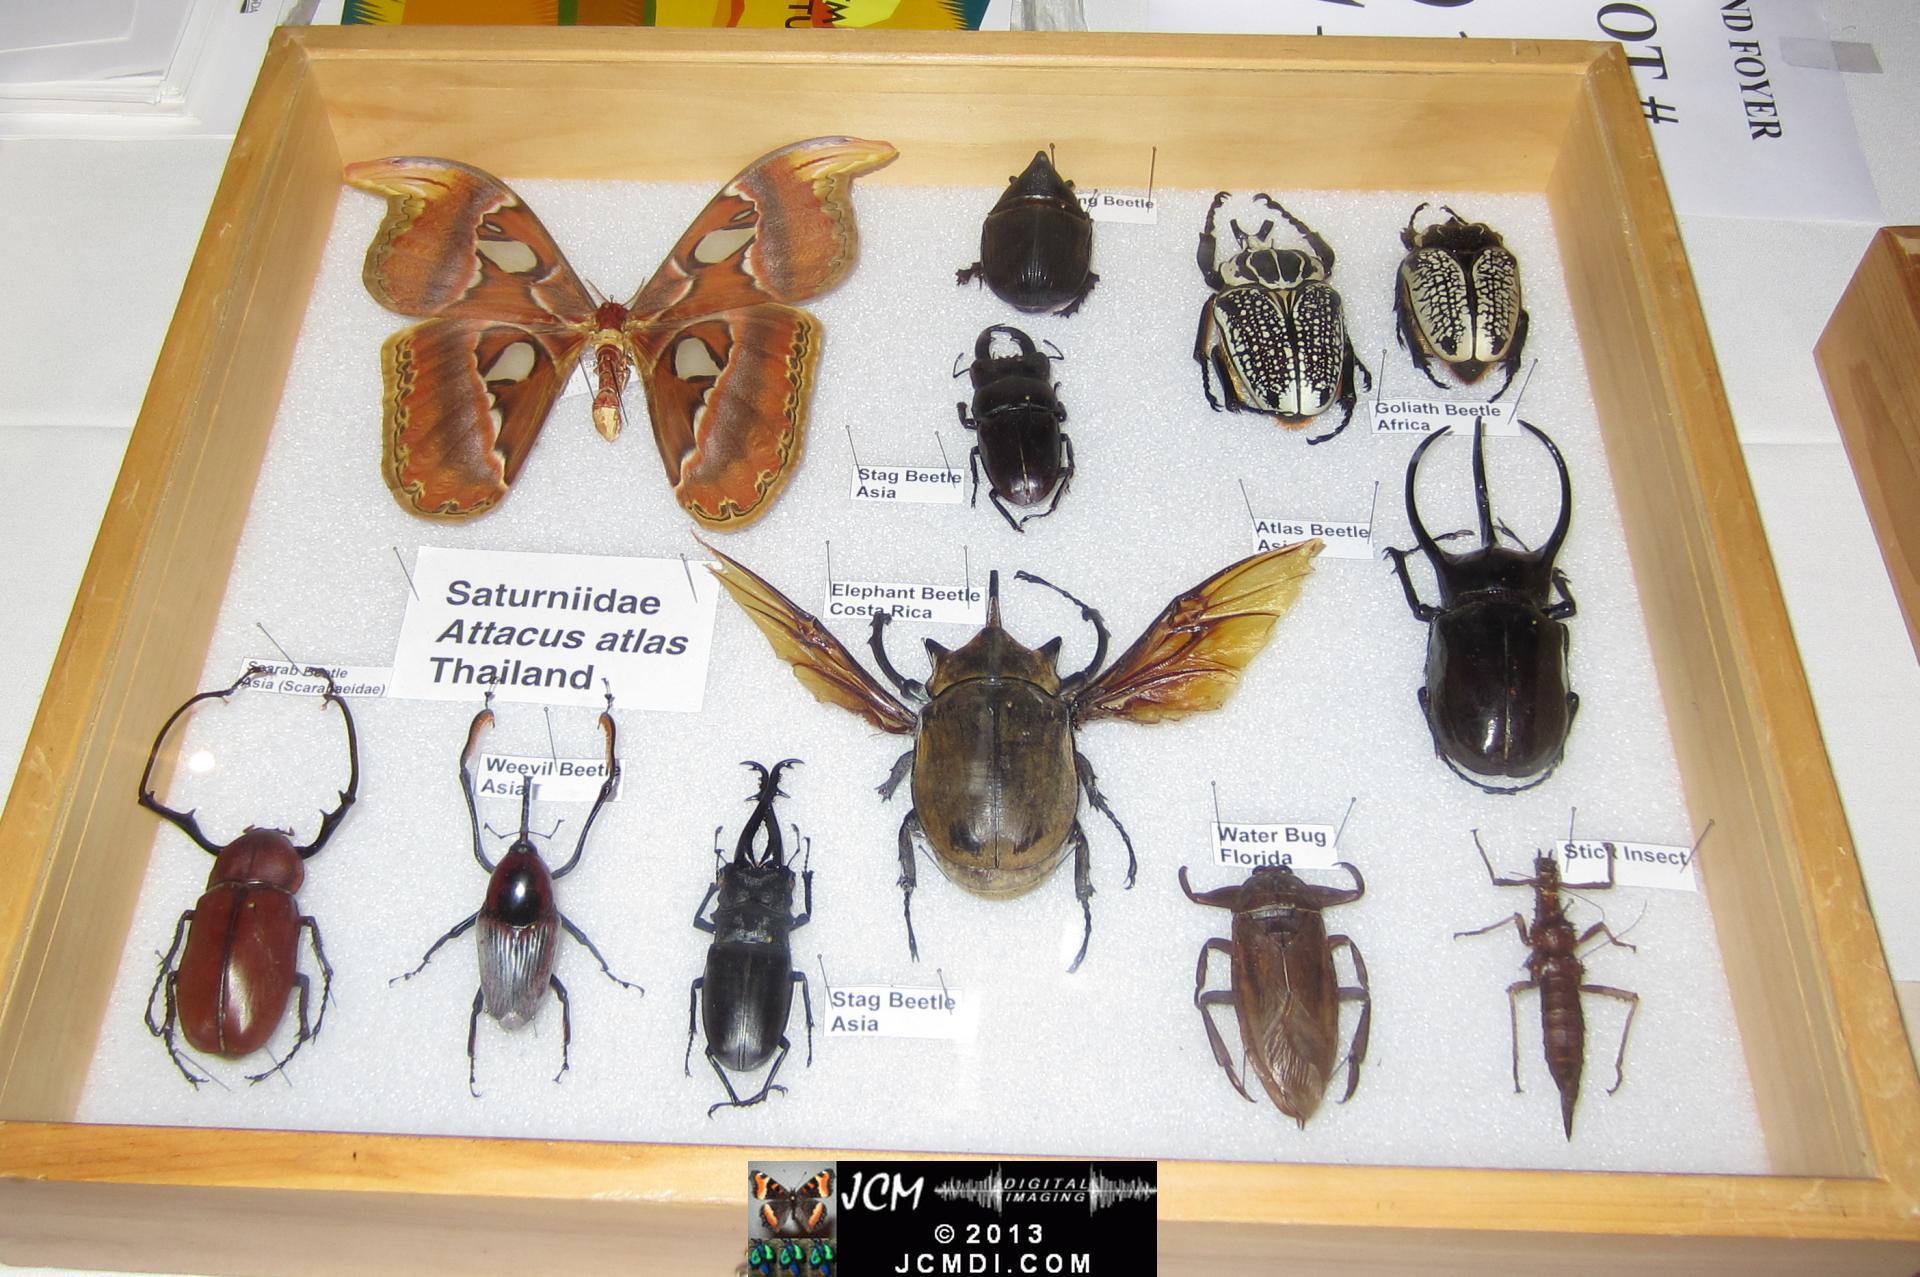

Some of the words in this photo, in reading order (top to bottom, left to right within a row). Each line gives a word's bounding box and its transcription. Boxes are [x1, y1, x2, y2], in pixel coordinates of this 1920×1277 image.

[1597, 0, 1668, 80] OT
[1728, 39, 1782, 140] FOYER
[1077, 197, 1098, 208] ng
[1103, 195, 1154, 209] Beetle
[1376, 401, 1440, 415] Goliath
[1445, 403, 1501, 417] Beetle
[1377, 418, 1431, 432] Africa
[858, 468, 899, 484] Stag
[905, 469, 962, 484] Beetle
[856, 485, 897, 499] Asia
[1256, 521, 1304, 535] Atlas
[1310, 523, 1369, 538] Beetle
[446, 580, 661, 615] Saturniidae
[832, 583, 916, 600] Elephant
[921, 586, 981, 602] Beetle
[830, 602, 885, 616] Costa
[891, 604, 933, 619] Rica
[435, 619, 586, 649] Attacus
[595, 628, 689, 655] atlas
[429, 656, 595, 690] Thailand
[278, 679, 386, 697] (Scaraaeidae)
[486, 757, 554, 776] Weevil
[1219, 826, 1279, 843] Water
[1285, 827, 1327, 848] Bug
[1220, 848, 1293, 865] Florida
[1564, 843, 1618, 860] Stic
[1624, 845, 1689, 866] Insect
[832, 991, 881, 1012] Stag
[889, 991, 956, 1011] Beetle
[831, 1015, 879, 1032] Asia
